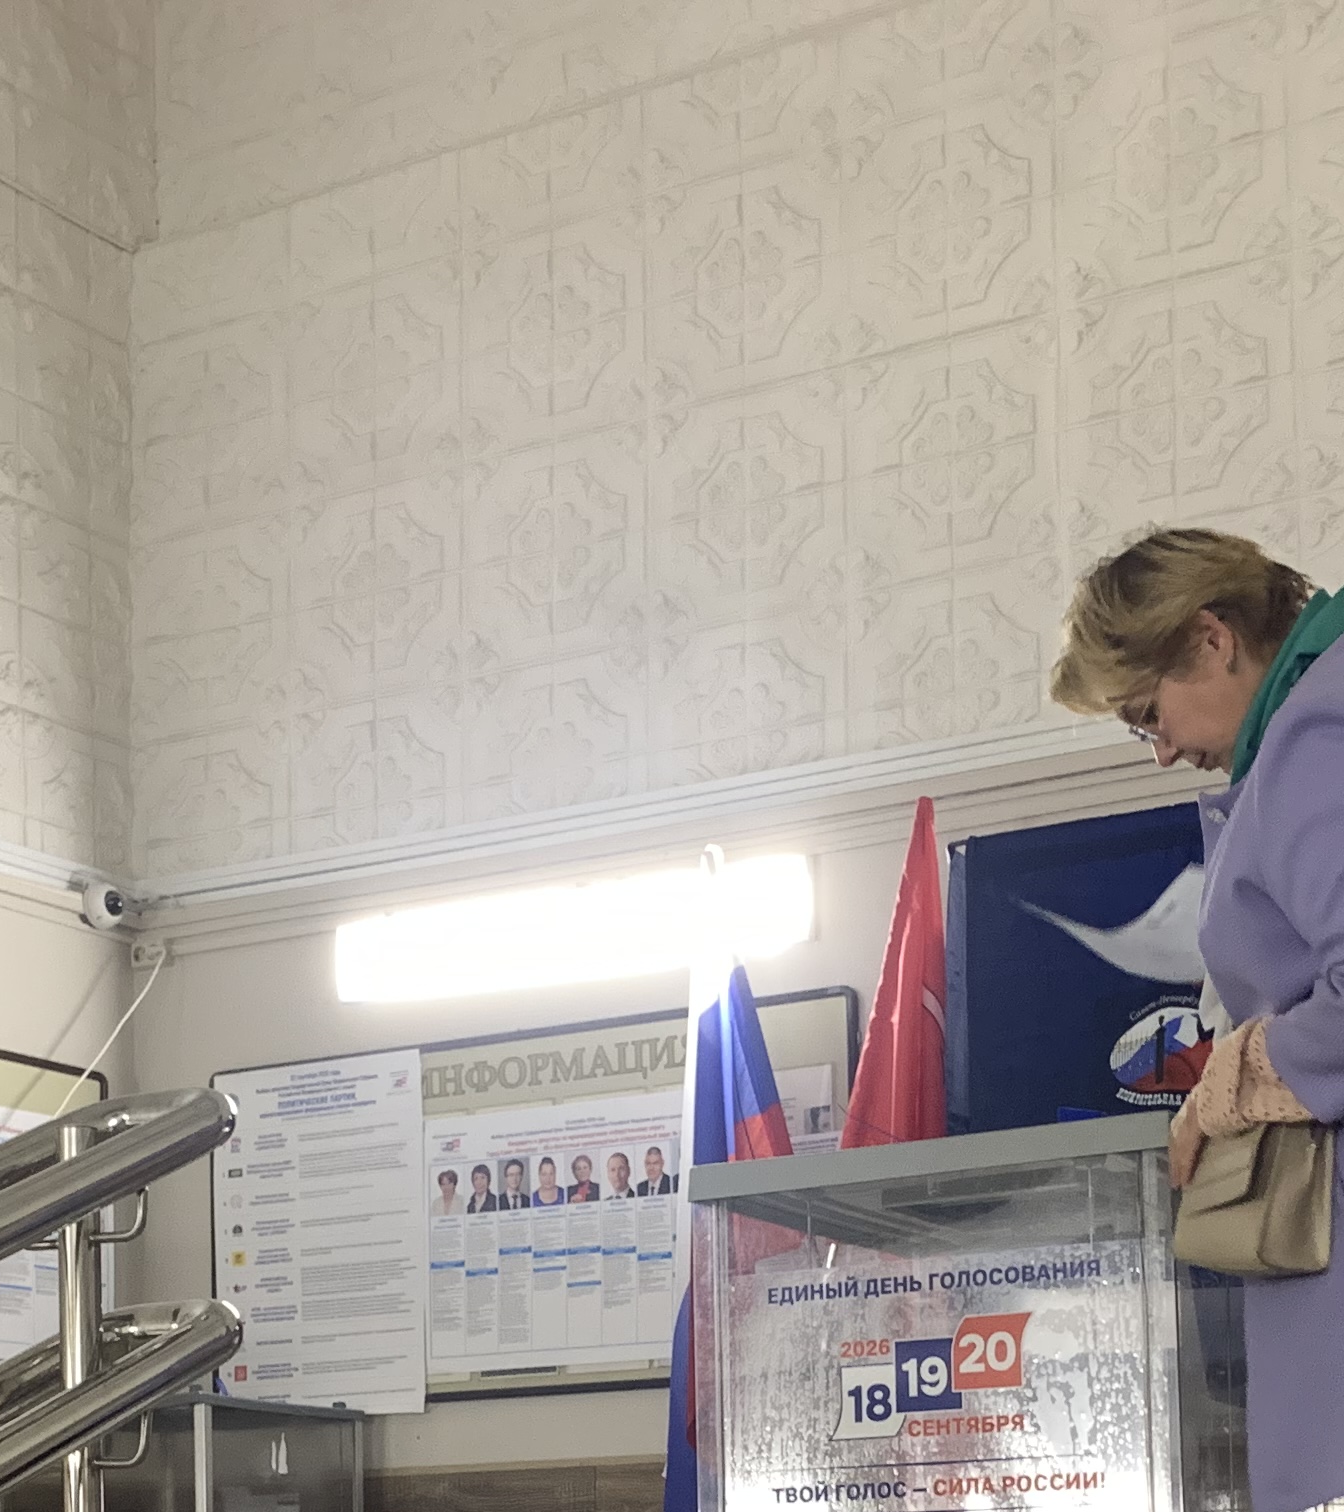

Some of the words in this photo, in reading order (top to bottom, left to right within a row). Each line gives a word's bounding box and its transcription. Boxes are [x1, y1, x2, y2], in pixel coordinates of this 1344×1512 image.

[422, 1033, 686, 1100] НФОРМАЦИ
[768, 1276, 858, 1306] ЕДИНЫЙ
[864, 1275, 922, 1299] ДЕНЬ
[928, 1259, 1101, 1290] ГОЛОСОВАНИЯ
[840, 1339, 891, 1359] 2026
[847, 1384, 892, 1423] 18
[901, 1356, 948, 1398] 19
[958, 1331, 1017, 1373] 20
[908, 1414, 1025, 1438] СЕНТЯБРЯ
[772, 1480, 830, 1504] ТВОЙ
[835, 1480, 907, 1500] ГОЛОС
[933, 1476, 996, 1496] СИЛА
[1001, 1471, 1106, 1494] РОССИИ!
